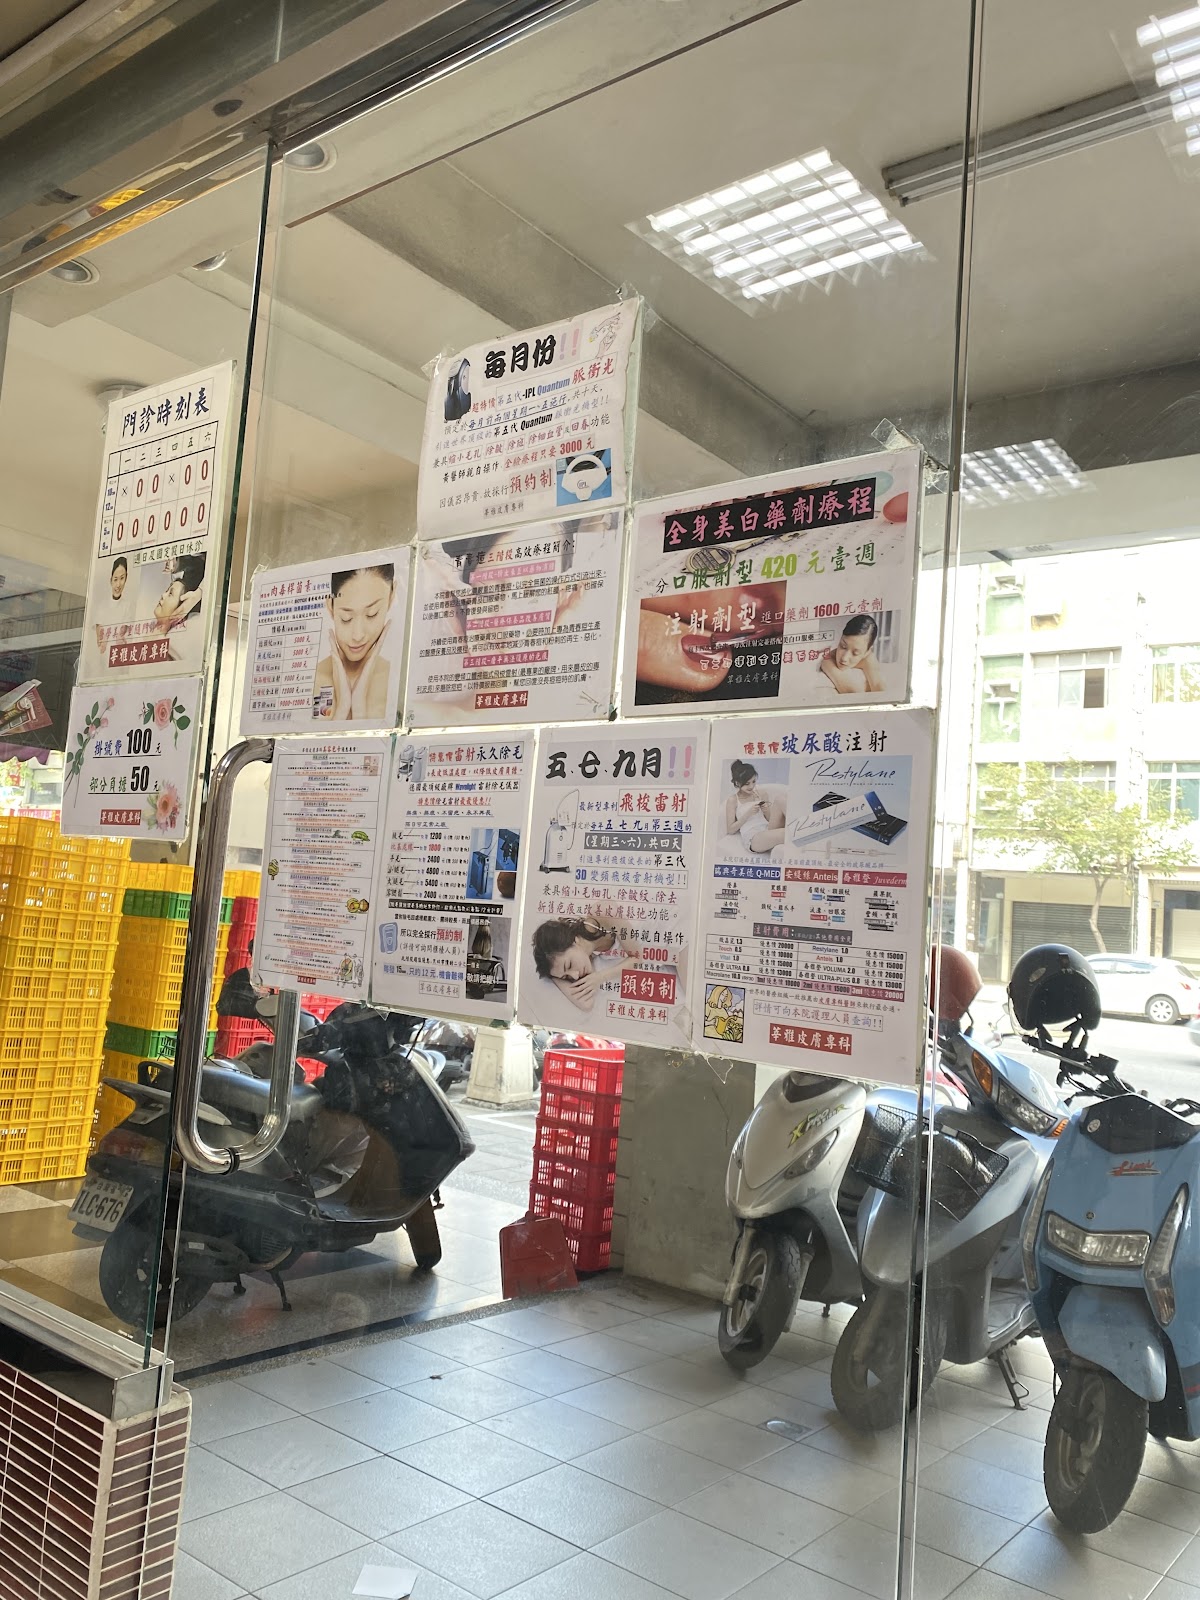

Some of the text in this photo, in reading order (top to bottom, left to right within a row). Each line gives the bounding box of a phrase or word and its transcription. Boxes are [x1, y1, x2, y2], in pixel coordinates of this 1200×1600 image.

[536, 377, 571, 396] Quantum
[122, 387, 209, 437] 門診時刻表
[520, 413, 553, 431] Quantum
[560, 439, 582, 455] 3000
[585, 437, 595, 450] 元
[665, 486, 872, 545] 全身美白藥劑療程
[761, 553, 798, 579] 420
[813, 603, 840, 618] 1600
[95, 728, 162, 756] 掛號費 100 元
[89, 765, 160, 793] 部分負擔 50 元
[805, 757, 896, 787] Restylane
[788, 802, 865, 836] Restylane
[430, 832, 442, 840] 1200
[575, 869, 587, 880] 3D
[756, 869, 781, 880] Q-MED
[813, 872, 838, 881] Anteis
[643, 947, 679, 964] 5000 元
[812, 945, 839, 953] Restylane
[841, 946, 849, 954] 1.0
[823, 965, 846, 973] VOLUMA
[886, 962, 903, 970] 15000
[817, 974, 851, 984] ULTRA-PLUS
[885, 981, 902, 989] 13000
[834, 985, 850, 993] 15000
